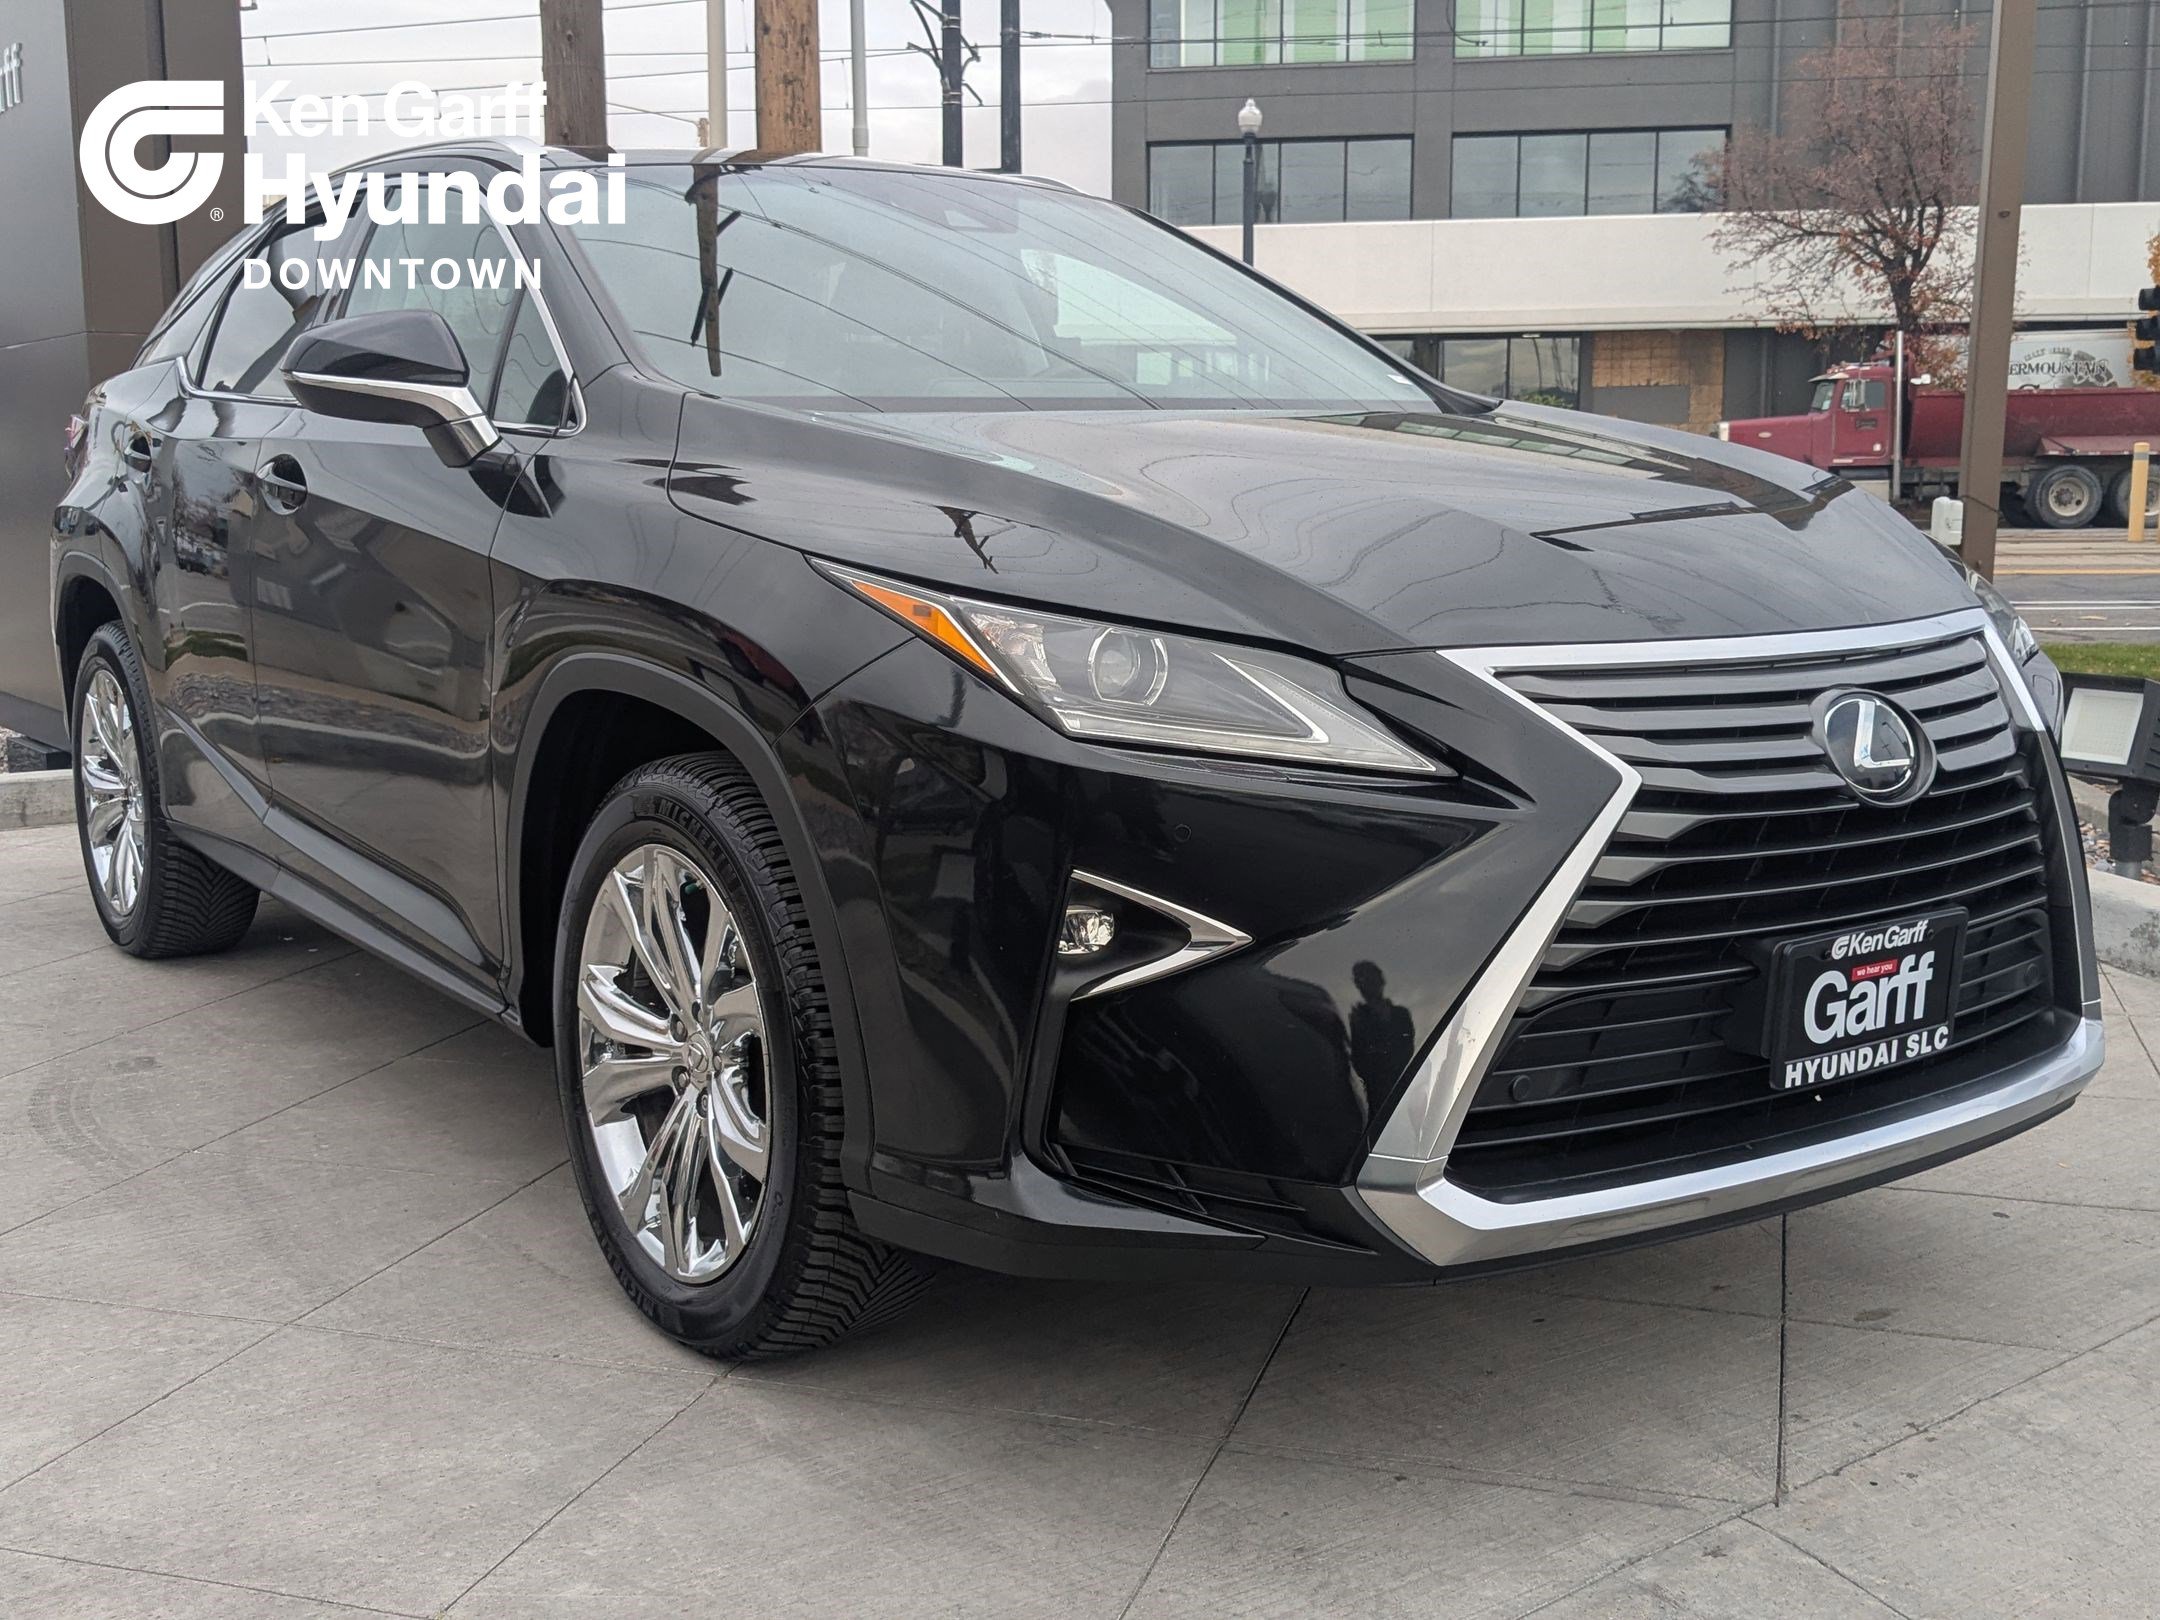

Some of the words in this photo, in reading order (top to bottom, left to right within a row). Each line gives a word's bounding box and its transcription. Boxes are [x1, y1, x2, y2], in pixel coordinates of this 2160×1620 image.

[1804, 951, 1935, 1045] Garff
[1856, 968, 1866, 977] we
[1866, 965, 1881, 974] hear
[1880, 963, 1893, 974] you
[1785, 1040, 1898, 1089] HYUNDAI
[1905, 1026, 1949, 1058] SLC
